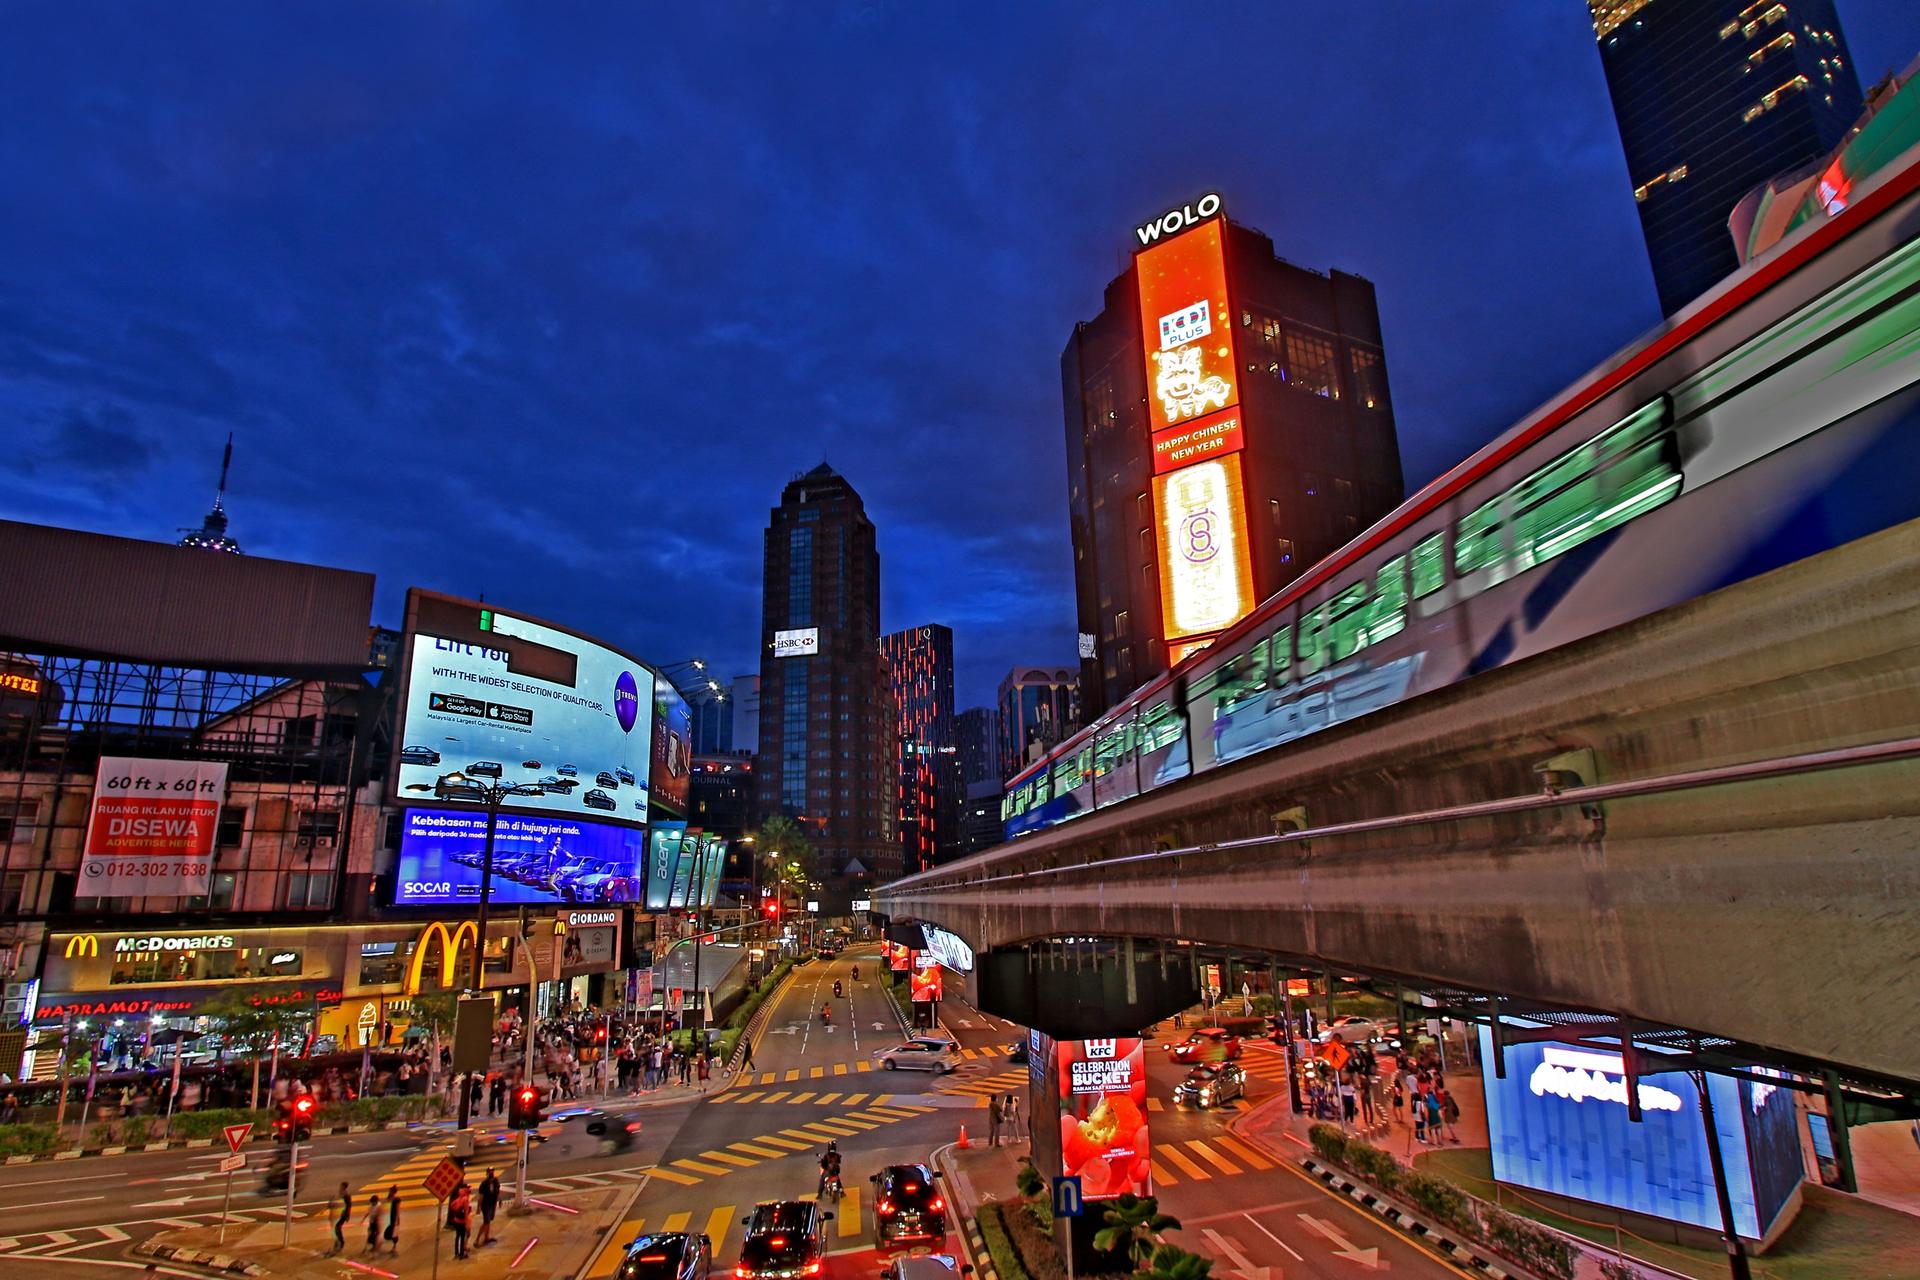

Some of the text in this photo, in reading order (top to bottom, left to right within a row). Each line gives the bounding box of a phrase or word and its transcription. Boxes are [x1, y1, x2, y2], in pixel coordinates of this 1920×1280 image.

[1137, 194, 1220, 244] WOLO
[1170, 326, 1203, 344] PLUS
[1156, 420, 1237, 452] HAPPY CHINESE
[1171, 438, 1224, 460] NEW YEAR
[777, 639, 801, 648] HSBC
[432, 667, 456, 678] WITH
[459, 671, 476, 682] THE
[478, 675, 510, 688] WIDEST
[512, 682, 552, 698] SELECTION
[563, 694, 588, 707] QUALITY
[589, 701, 602, 711] CARS
[622, 691, 637, 702] TREVO
[446, 702, 482, 715] Google Play
[427, 714, 455, 722] Malaysia's
[478, 720, 504, 729] Car-Rental
[505, 725, 531, 734] Marketplace
[501, 712, 529, 722] App Store
[107, 777, 216, 792] 60 ft x 60 ft
[98, 806, 215, 816] RUANG IKLAN UNTUK
[109, 819, 198, 836] DISEWA
[412, 816, 580, 834] Kebebasan meilih di hujung jari anda.
[428, 830, 458, 838] daripada
[106, 838, 197, 848] ADVERTISE HERE
[657, 841, 669, 880] acer
[108, 863, 206, 876] 012-302 7638
[405, 882, 450, 893] SOCAR
[570, 912, 614, 925] GIORDANO
[115, 935, 233, 951] McDonald's
[37, 1001, 152, 1018] HADRAMOT
[1090, 1048, 1111, 1056] KFC
[1072, 1060, 1130, 1073] CELEBRATION
[1072, 1071, 1130, 1086] BUCKET
